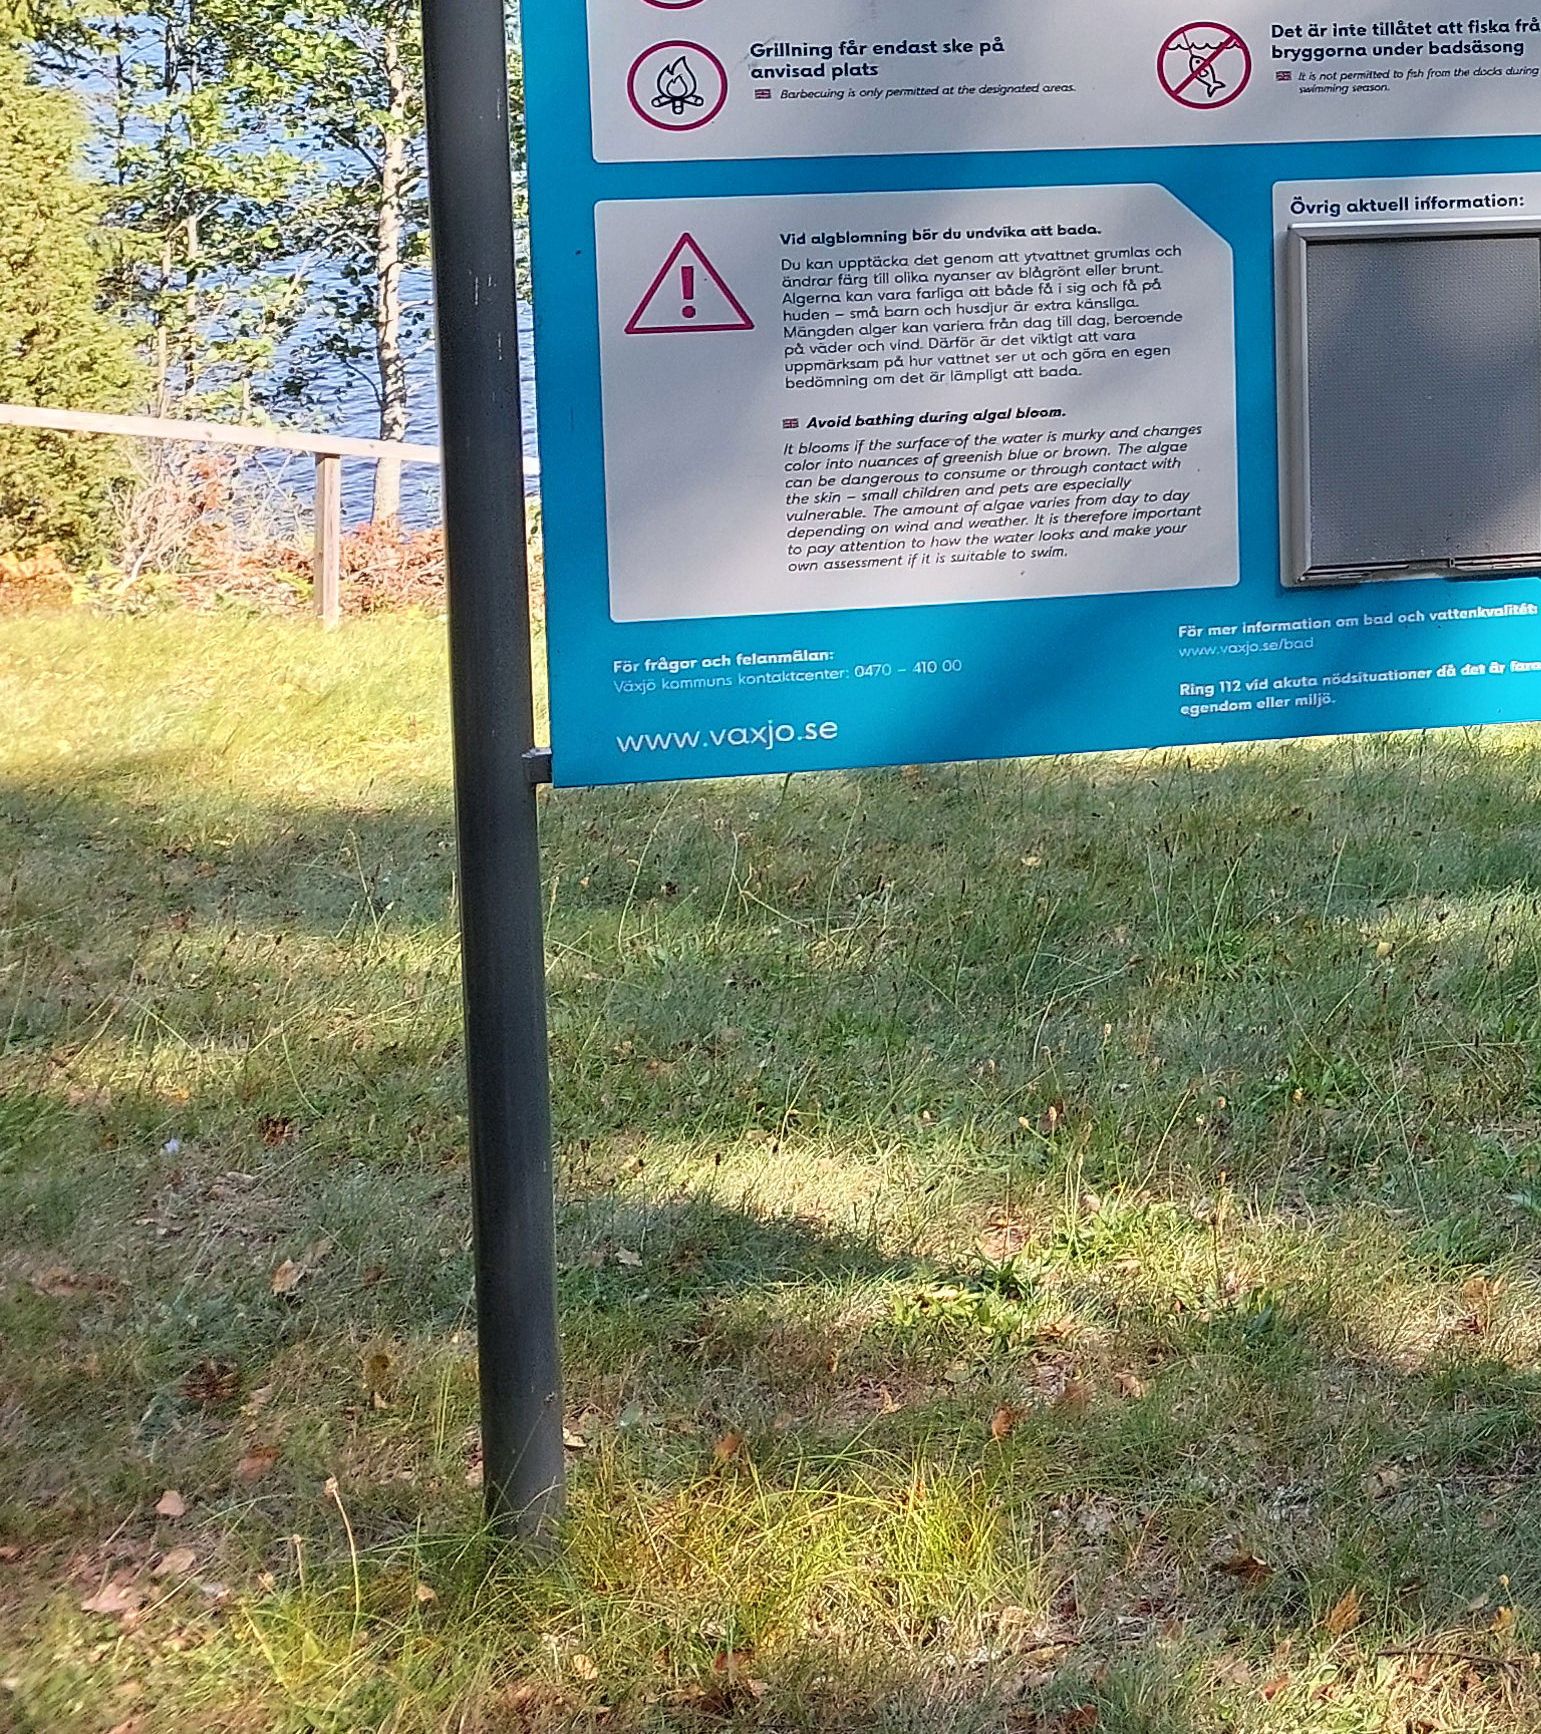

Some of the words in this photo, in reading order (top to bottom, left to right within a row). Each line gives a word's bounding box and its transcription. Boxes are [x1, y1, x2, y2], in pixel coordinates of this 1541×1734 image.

[1271, 24, 1303, 39] Det
[1307, 23, 1328, 38] är
[1332, 22, 1367, 37] inte
[1371, 19, 1433, 37] tillåtet
[1437, 21, 1463, 35] att
[1467, 19, 1511, 34] fiska
[749, 41, 833, 61] Grillning
[837, 39, 868, 56] får
[872, 39, 938, 55] endast
[942, 38, 974, 53] ske
[979, 36, 1005, 57] på
[1271, 44, 1368, 63] bryggorna
[1372, 41, 1424, 57] under
[1428, 39, 1524, 57] badsäsong
[750, 60, 826, 80] anvisad
[831, 61, 879, 81] plats
[1290, 195, 1341, 218] Övrig
[1346, 196, 1409, 213] aktuell
[1414, 193, 1525, 211] information:
[779, 232, 806, 245] Vid
[811, 229, 907, 248] algblomning
[912, 228, 939, 241] bör
[942, 227, 962, 240] du
[965, 225, 1027, 239] undvika
[1030, 225, 1053, 237] att
[1057, 223, 1102, 236] bada.
[806, 415, 852, 429] Avoid
[854, 412, 915, 428] bathing
[918, 410, 969, 425] during
[972, 407, 1013, 424] algal
[1015, 406, 1067, 419] bloom.
[787, 561, 819, 572] own
[823, 555, 903, 570] assessment
[907, 552, 919, 569] if
[921, 553, 930, 565] it
[935, 552, 946, 564] is
[950, 548, 1007, 563] suitable
[1011, 548, 1026, 560] to
[1030, 545, 1068, 559] swim.
[1178, 625, 1204, 638] För
[1207, 625, 1238, 636] mer
[1242, 617, 1331, 634] information
[1335, 617, 1359, 627] om
[1363, 612, 1393, 625] bad
[1397, 609, 1425, 623] och
[613, 660, 639, 673] För
[643, 656, 698, 674] frågor
[701, 654, 731, 668] och
[735, 649, 834, 666] felanmälan:
[1179, 683, 1215, 698] Ring
[1219, 679, 1241, 693] 112
[1245, 678, 1269, 691] vid
[1272, 676, 1318, 689] akuta
[1322, 669, 1433, 686] nödsituationer
[1435, 663, 1457, 677] då
[1180, 699, 1253, 718] egendom
[1255, 696, 1291, 709] eller
[616, 719, 838, 753] www.vaxjo.se
